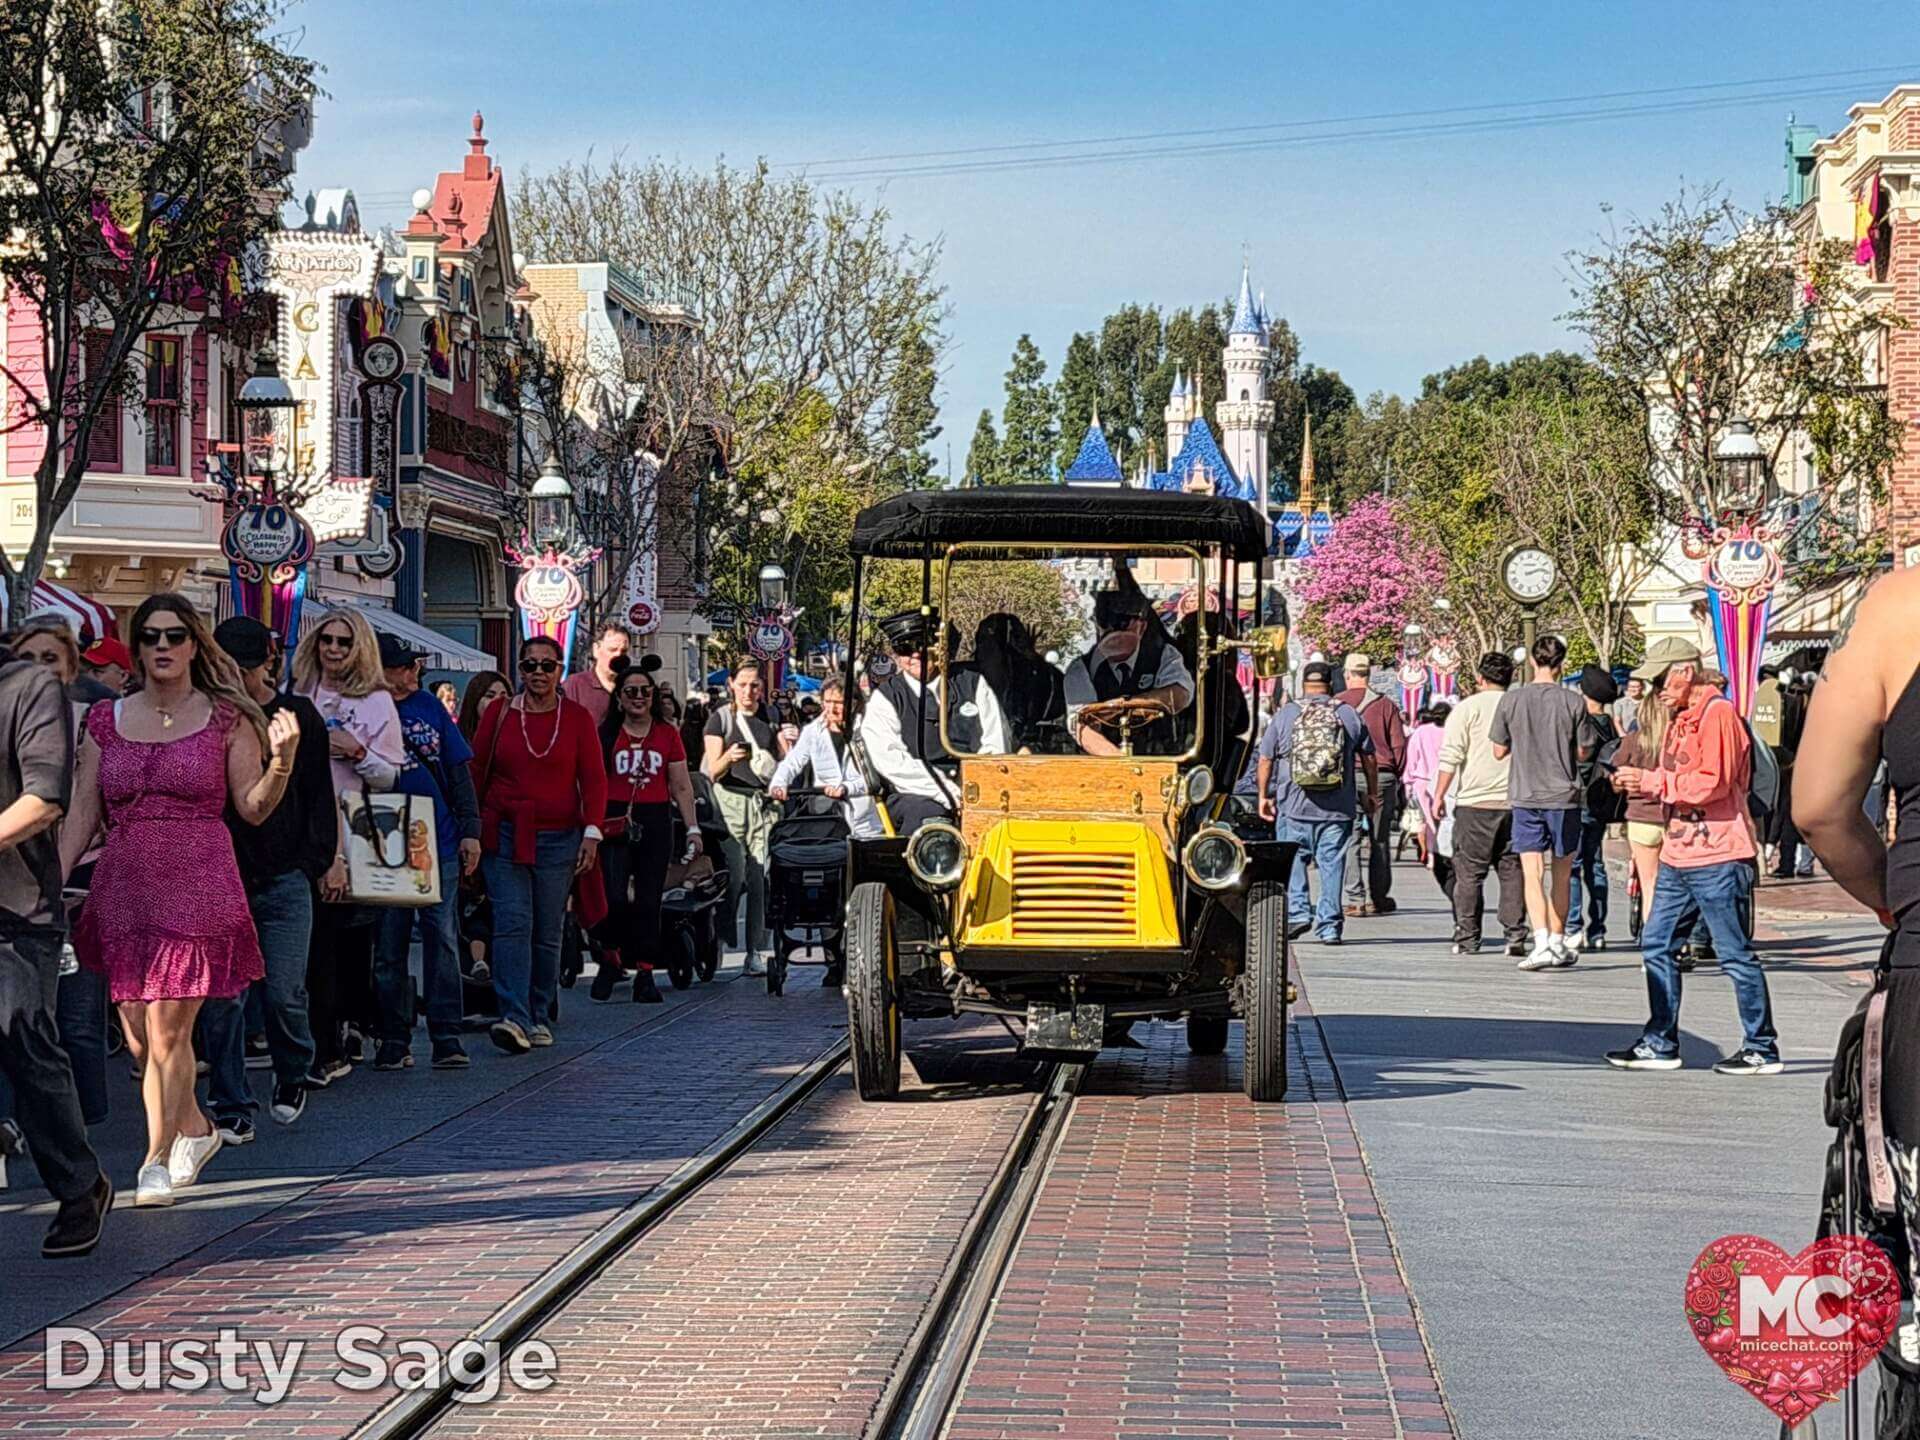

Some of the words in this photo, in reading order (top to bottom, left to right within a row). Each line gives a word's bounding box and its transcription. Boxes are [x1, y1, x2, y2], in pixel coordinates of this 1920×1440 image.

[256, 251, 361, 276] CARNATION
[248, 504, 287, 530] 70
[1728, 540, 1764, 561] 70
[535, 566, 566, 585] 70
[762, 624, 780, 636] 70
[412, 734, 430, 745] 70
[615, 750, 663, 776] GAP
